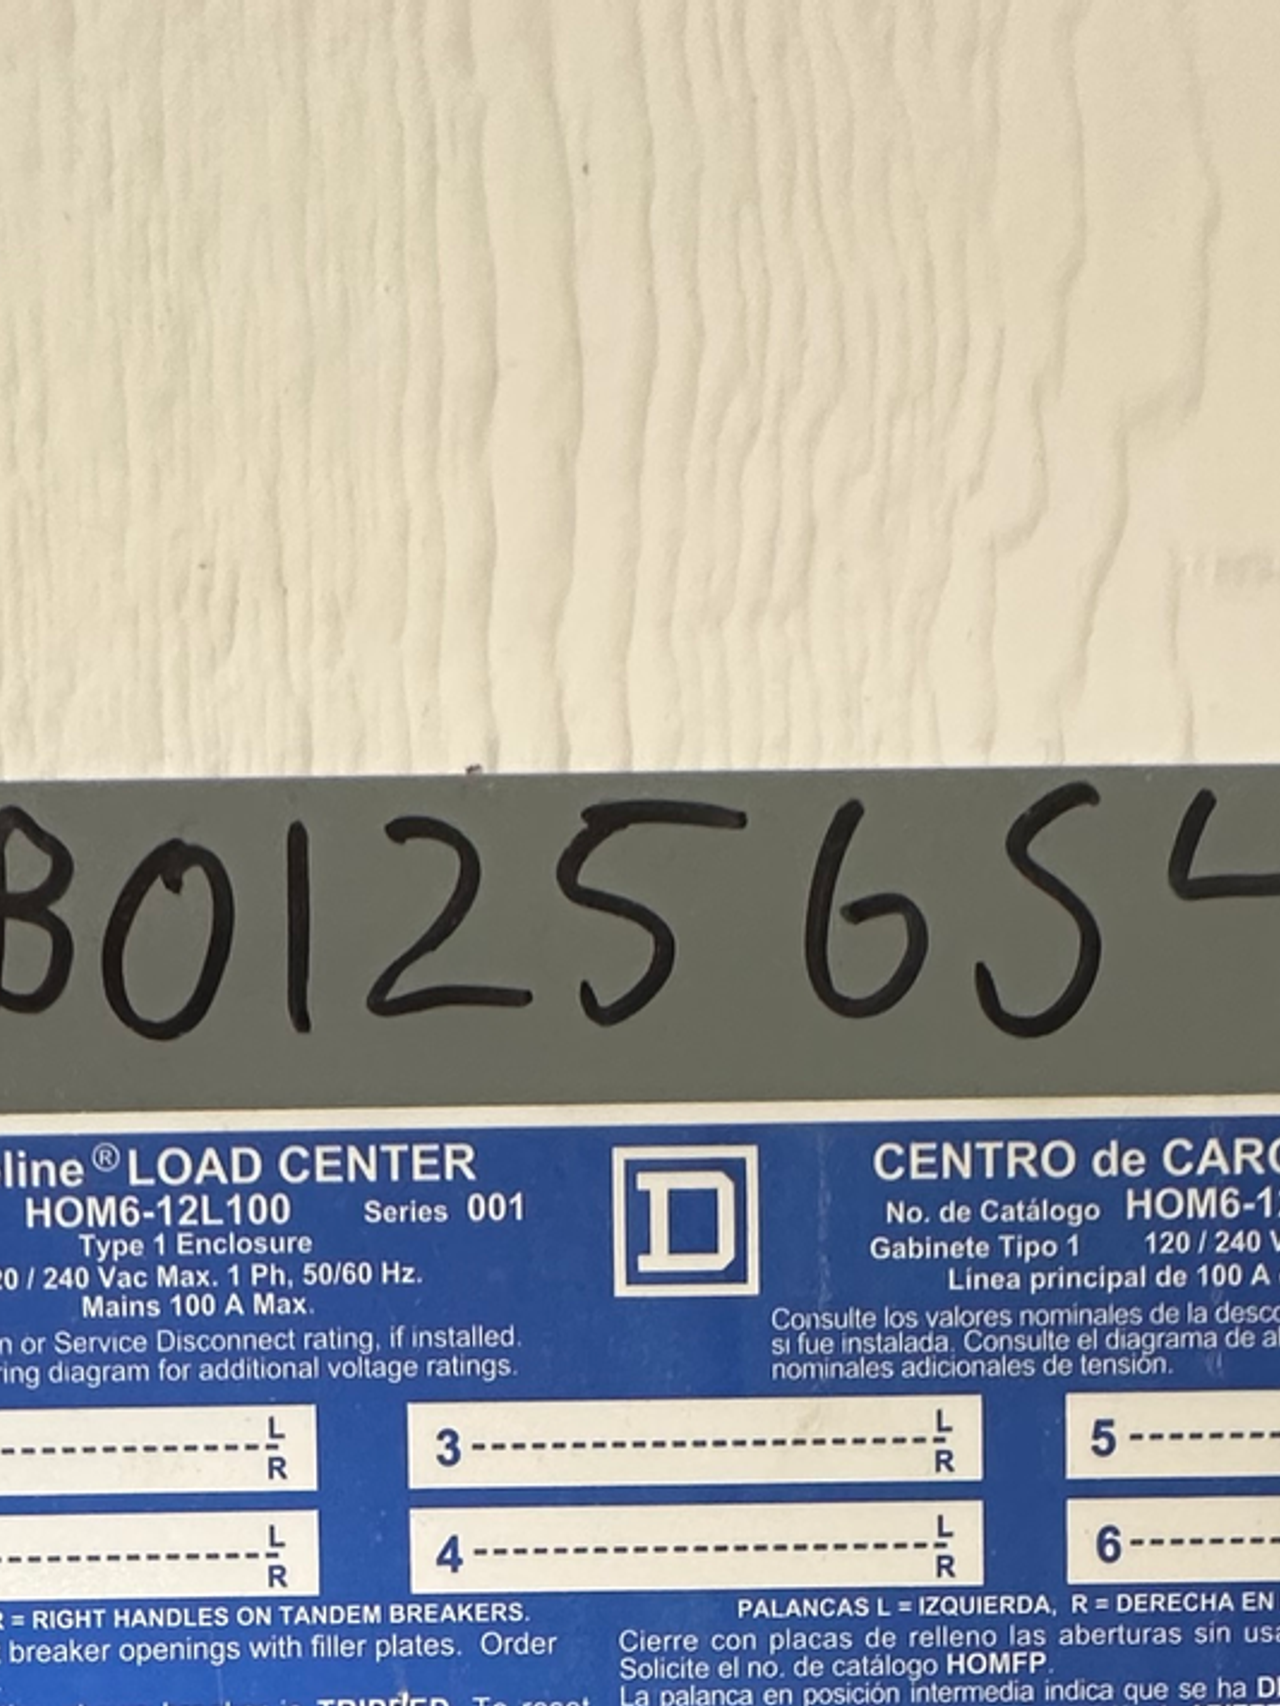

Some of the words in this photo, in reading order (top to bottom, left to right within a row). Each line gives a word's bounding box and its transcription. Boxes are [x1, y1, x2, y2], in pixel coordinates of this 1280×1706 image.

[128, 1146, 262, 1187] LOAD
[278, 1143, 476, 1184] CENTER
[873, 1139, 1076, 1181] CENTRO
[1092, 1139, 1146, 1178] de
[25, 1192, 291, 1229] HOM6-12L100
[364, 1199, 449, 1223] Series
[467, 1192, 523, 1222] 001
[886, 1200, 930, 1224] No.
[939, 1200, 971, 1223] de
[980, 1198, 1101, 1227] Catálogo
[78, 1233, 145, 1263] Type
[153, 1232, 165, 1256] 1
[177, 1231, 313, 1256] Enclosure
[870, 1236, 990, 1260] Gabinete
[998, 1234, 1058, 1262] Tipo
[1067, 1233, 1078, 1257] 1
[1145, 1230, 1191, 1254] 120
[1197, 1229, 1208, 1254] /
[1215, 1229, 1261, 1254] 240
[27, 1267, 35, 1290] /
[43, 1266, 90, 1290] 240
[97, 1265, 148, 1289] Vac
[157, 1264, 218, 1288] Max.
[227, 1264, 239, 1287] 1
[251, 1263, 293, 1288] Ph,
[303, 1261, 373, 1286] 50/60
[381, 1261, 423, 1284] Hz.
[948, 1261, 1025, 1290] Línea
[1030, 1262, 1147, 1296] principal
[1155, 1264, 1188, 1288] de
[1196, 1263, 1243, 1287] 100
[1250, 1263, 1271, 1286] A
[82, 1294, 161, 1318] Mains
[170, 1293, 216, 1317] 100
[224, 1292, 245, 1316] A
[253, 1292, 314, 1315] Max.
[268, 1416, 285, 1439] L
[936, 1408, 953, 1433] L
[436, 1428, 461, 1467] 3
[1091, 1418, 1116, 1458] 5
[268, 1456, 287, 1480] R
[935, 1449, 955, 1473] R
[269, 1525, 286, 1548] L
[937, 1514, 954, 1538] L
[436, 1535, 463, 1573] 4
[1096, 1525, 1122, 1564] 6
[268, 1564, 287, 1588] R
[936, 1554, 956, 1578] R
[9, 1638, 111, 1664] breaker
[118, 1636, 241, 1667] openings
[248, 1634, 303, 1659] with
[310, 1633, 367, 1658] filler
[375, 1633, 462, 1663] plates.
[480, 1631, 558, 1656] Order
[619, 1656, 710, 1681] Solicite
[717, 1656, 739, 1679] el
[747, 1660, 785, 1679] no.
[793, 1655, 824, 1678] de
[831, 1653, 939, 1685] catálogo
